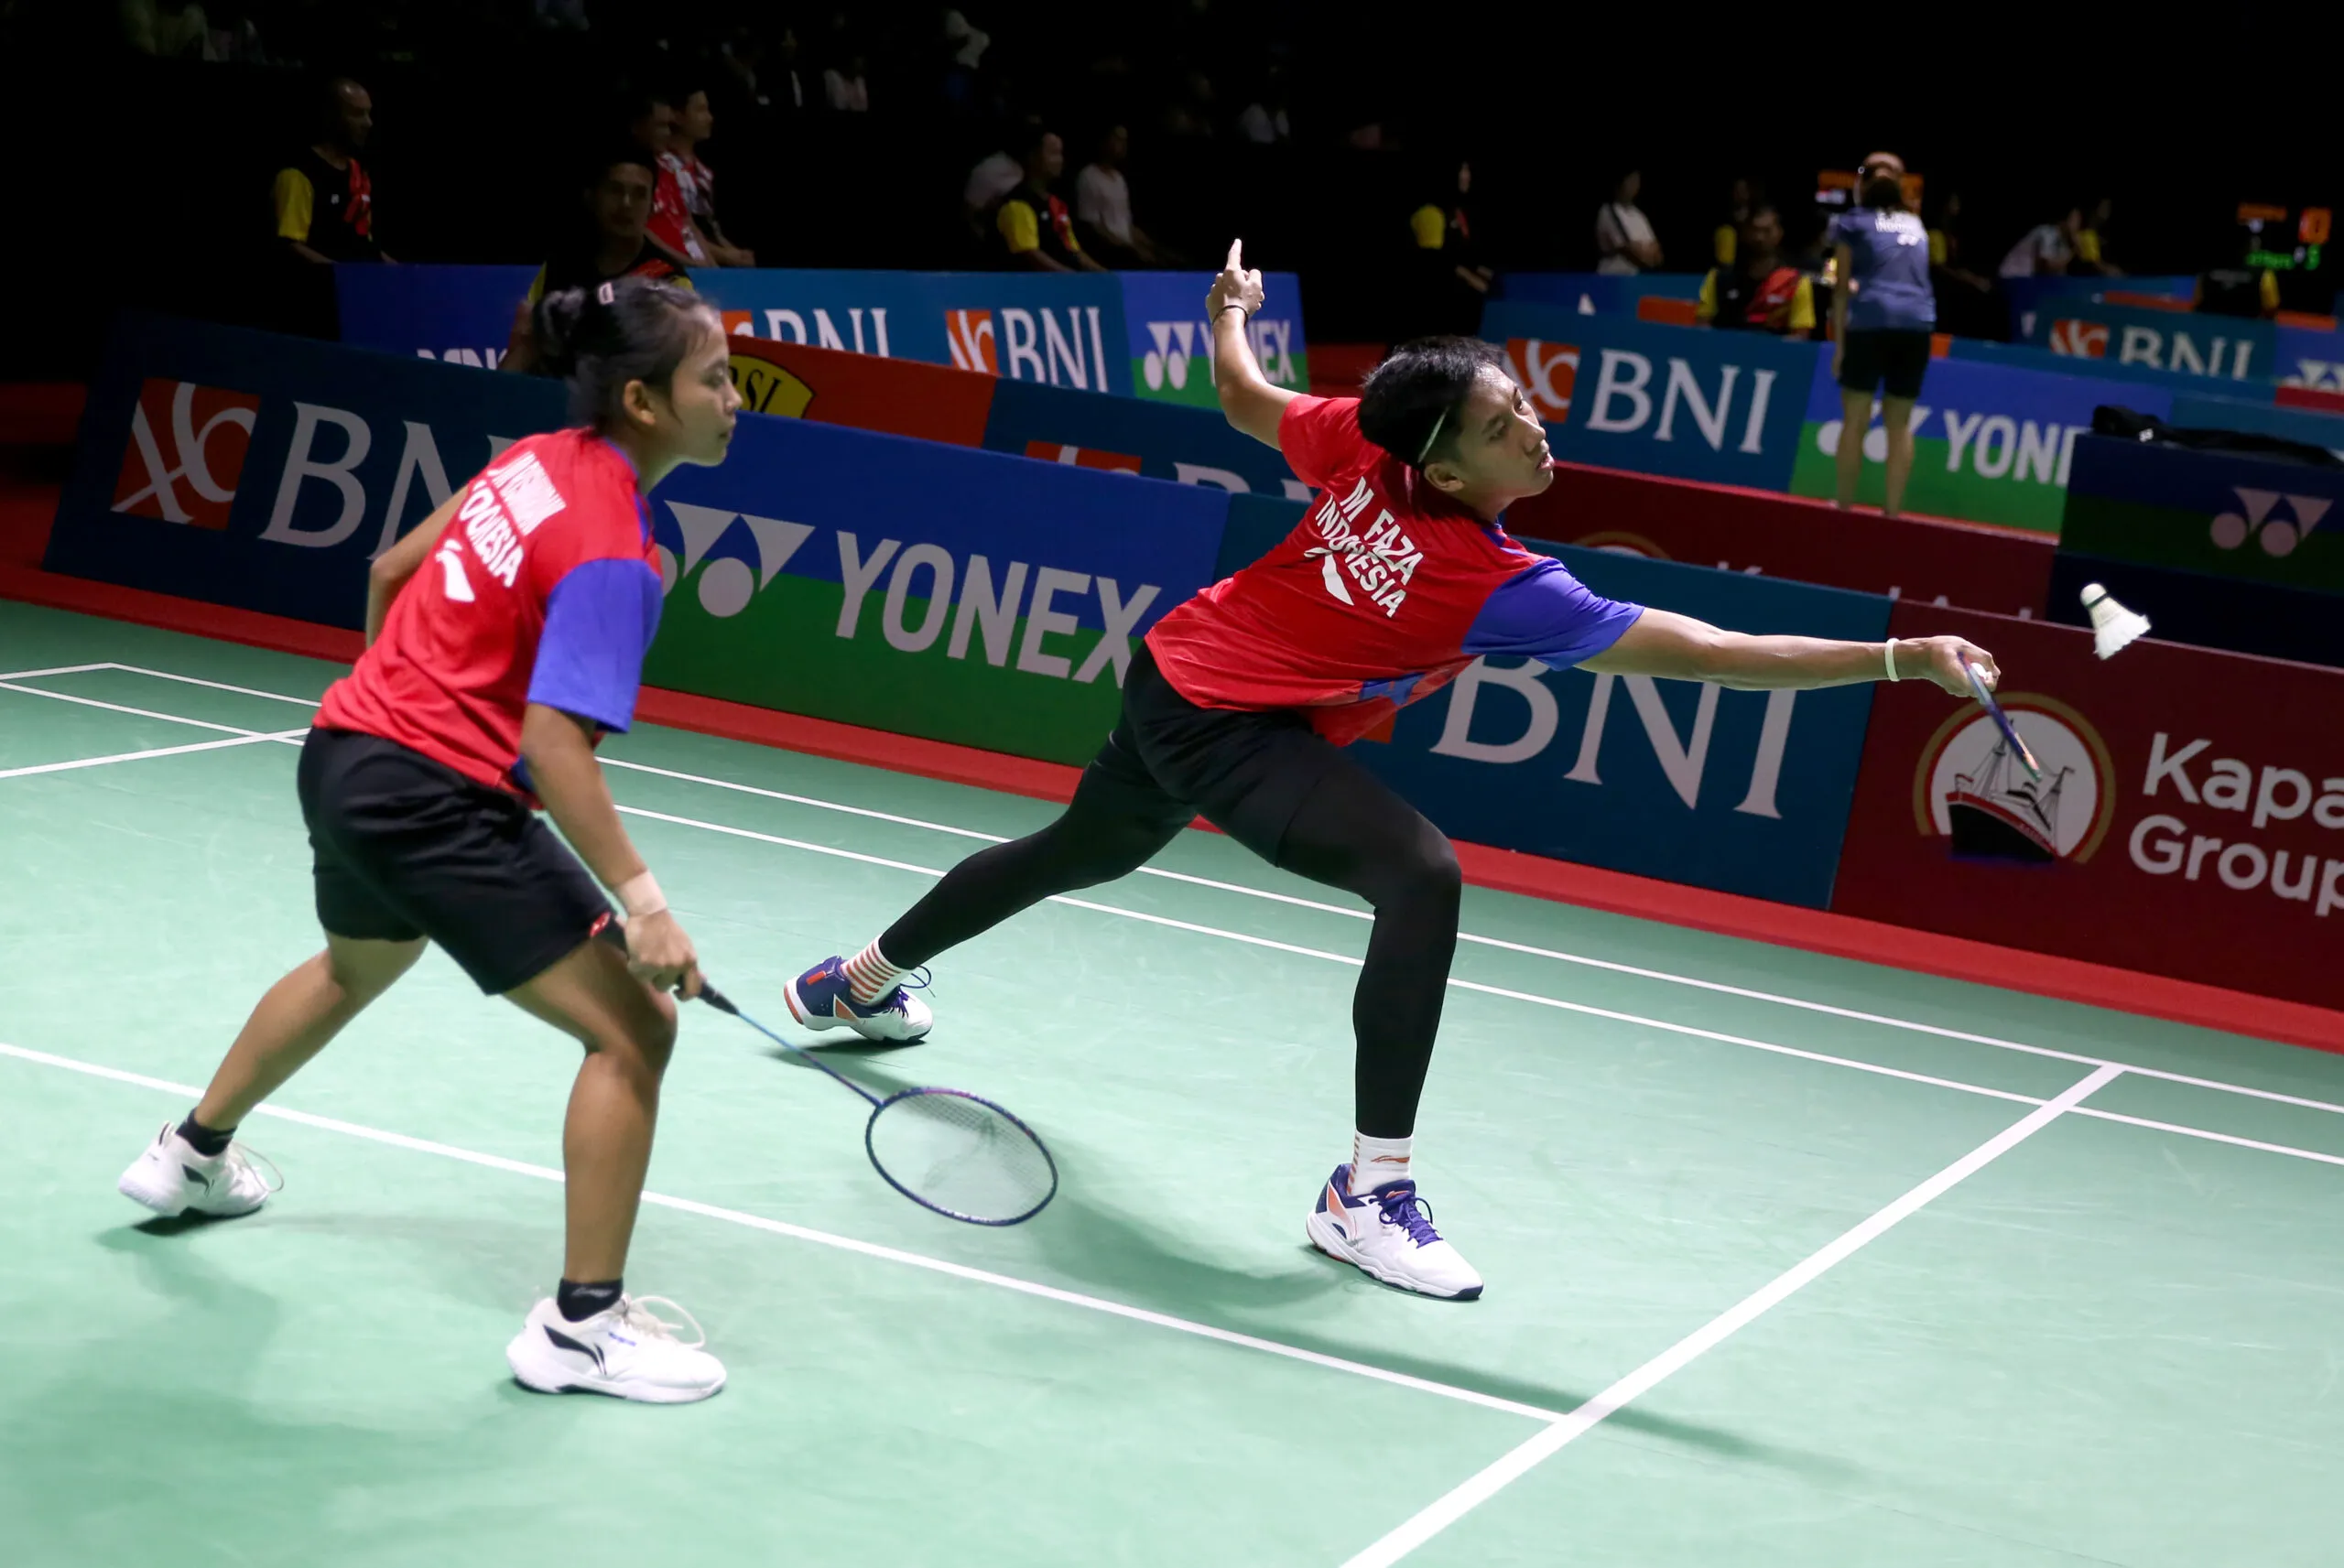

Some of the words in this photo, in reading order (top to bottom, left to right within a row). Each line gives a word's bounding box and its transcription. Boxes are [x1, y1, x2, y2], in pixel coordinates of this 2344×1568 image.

[1001, 307, 1109, 394] BNI
[1586, 348, 1779, 455] BNI
[2119, 325, 2255, 381] BNI
[1315, 494, 1407, 618] INDONESIA
[1340, 476, 1374, 522] M
[1363, 508, 1424, 586] FAZA
[835, 529, 1161, 689] YONEX
[1429, 654, 1796, 819] BNI
